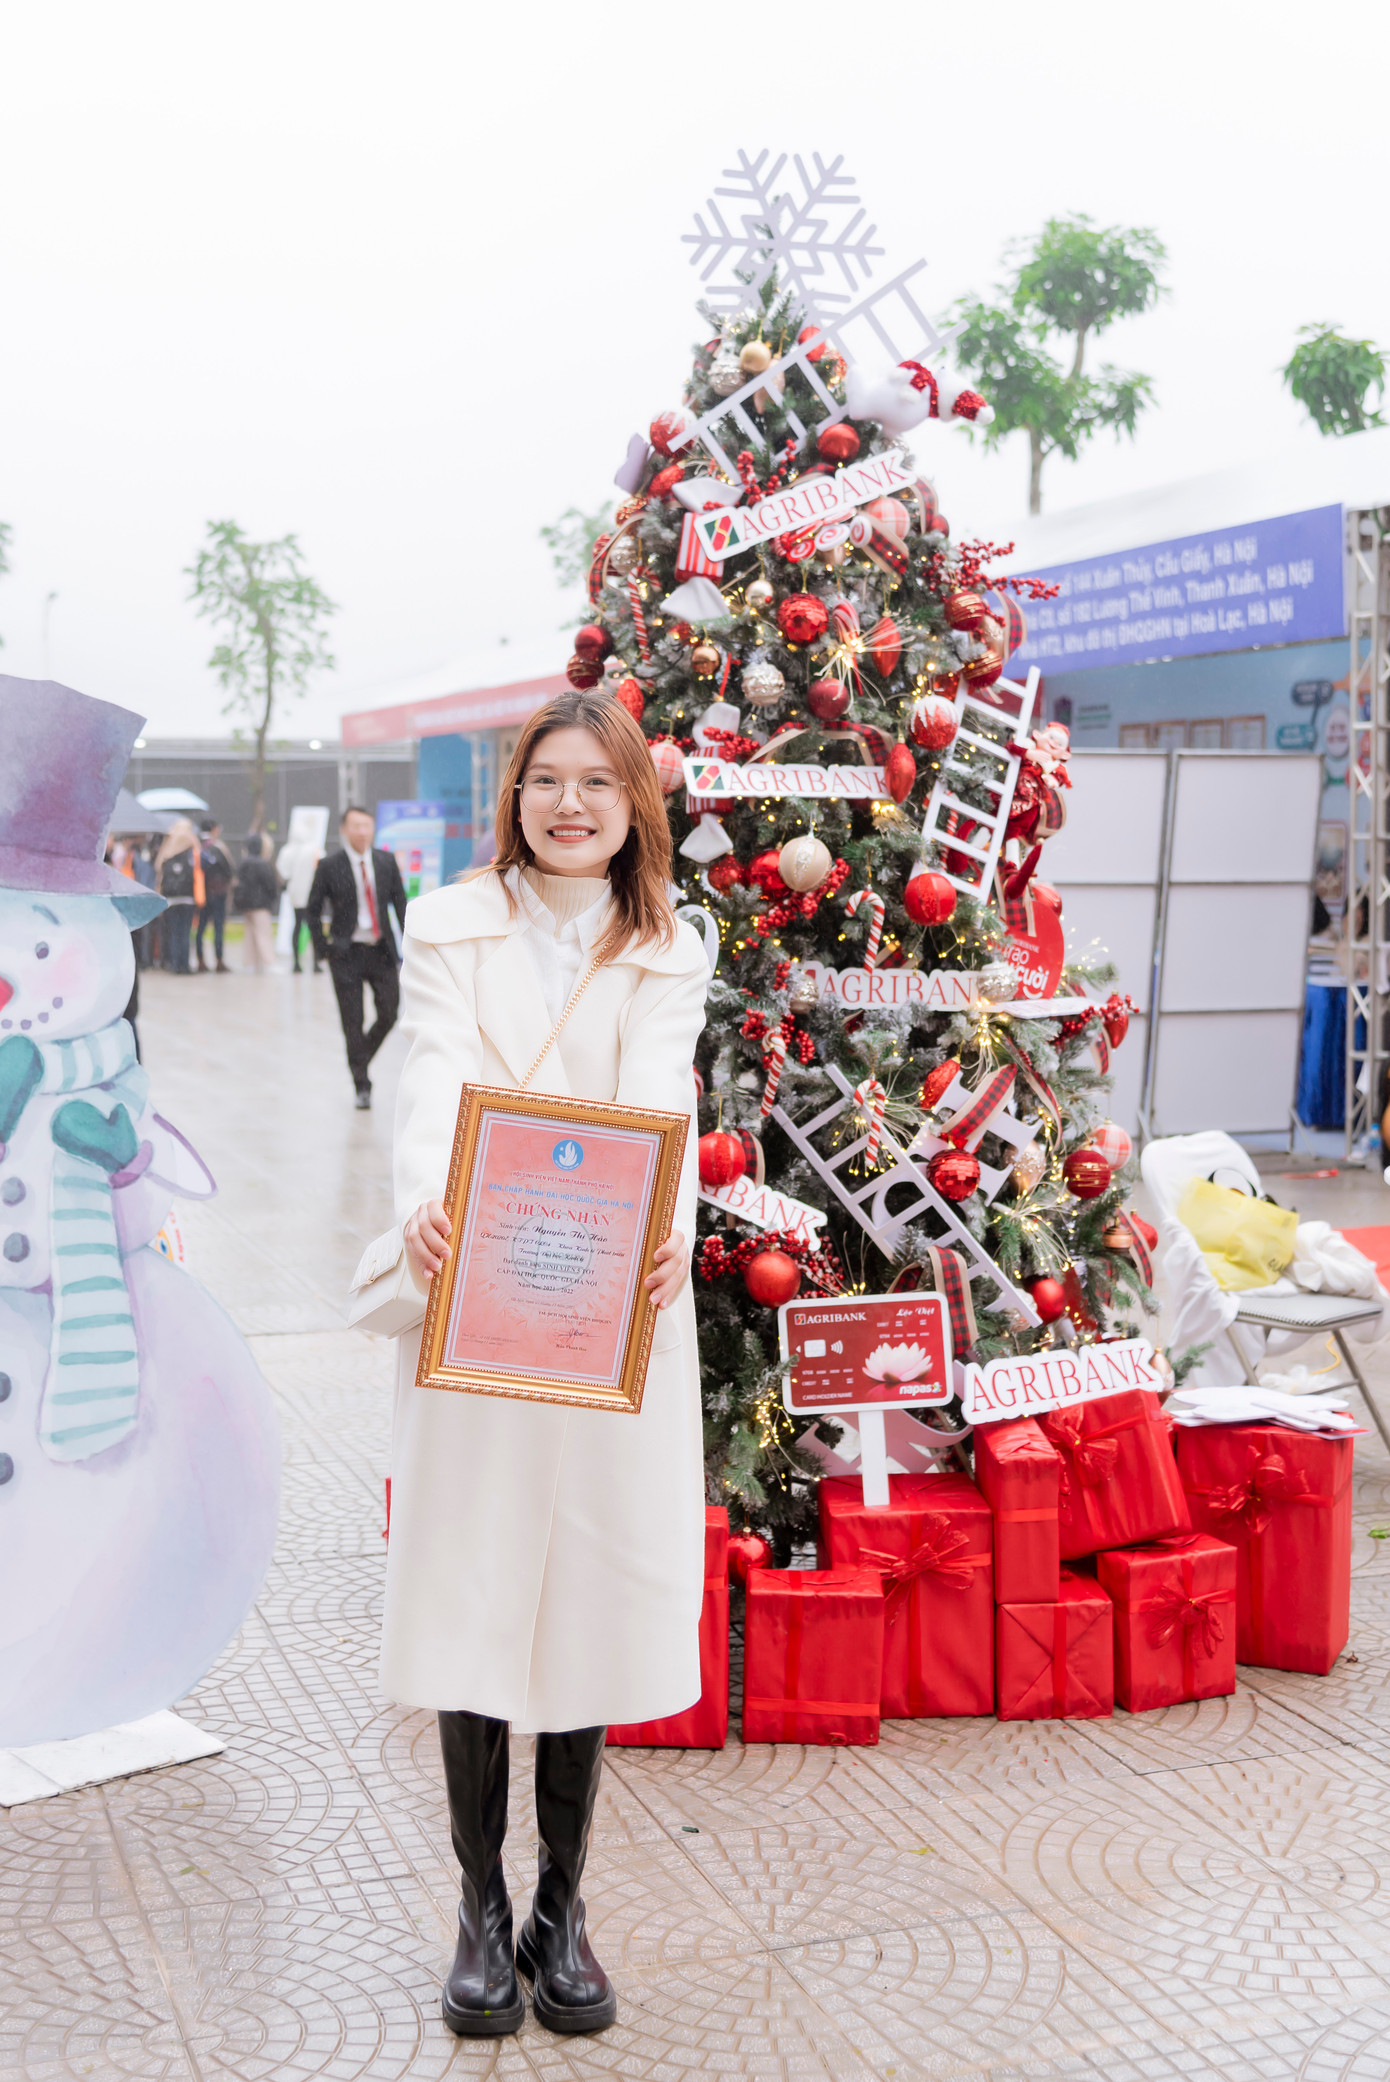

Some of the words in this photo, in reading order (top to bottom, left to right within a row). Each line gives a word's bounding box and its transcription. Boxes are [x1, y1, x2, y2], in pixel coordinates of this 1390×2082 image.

[741, 455, 908, 540] AGRIBANK
[1212, 541, 1233, 566] Hà
[1232, 536, 1259, 566] Nội
[1185, 575, 1226, 603] Thanh
[1265, 564, 1287, 589] Hà
[1287, 559, 1315, 590] Nội
[1246, 601, 1267, 625] Hà
[1268, 596, 1295, 627] Nội
[728, 769, 887, 796] AGRIBANK
[823, 974, 980, 1005] AGRIBAN
[488, 1182, 502, 1190] BAN
[596, 1198, 608, 1206] GIA
[506, 1201, 562, 1220] CHỨNG
[567, 1209, 609, 1227] NHẬN
[806, 1311, 867, 1325] AGRIBANK
[899, 1385, 932, 1397] napas
[971, 1346, 1156, 1413] AGRIBANK
